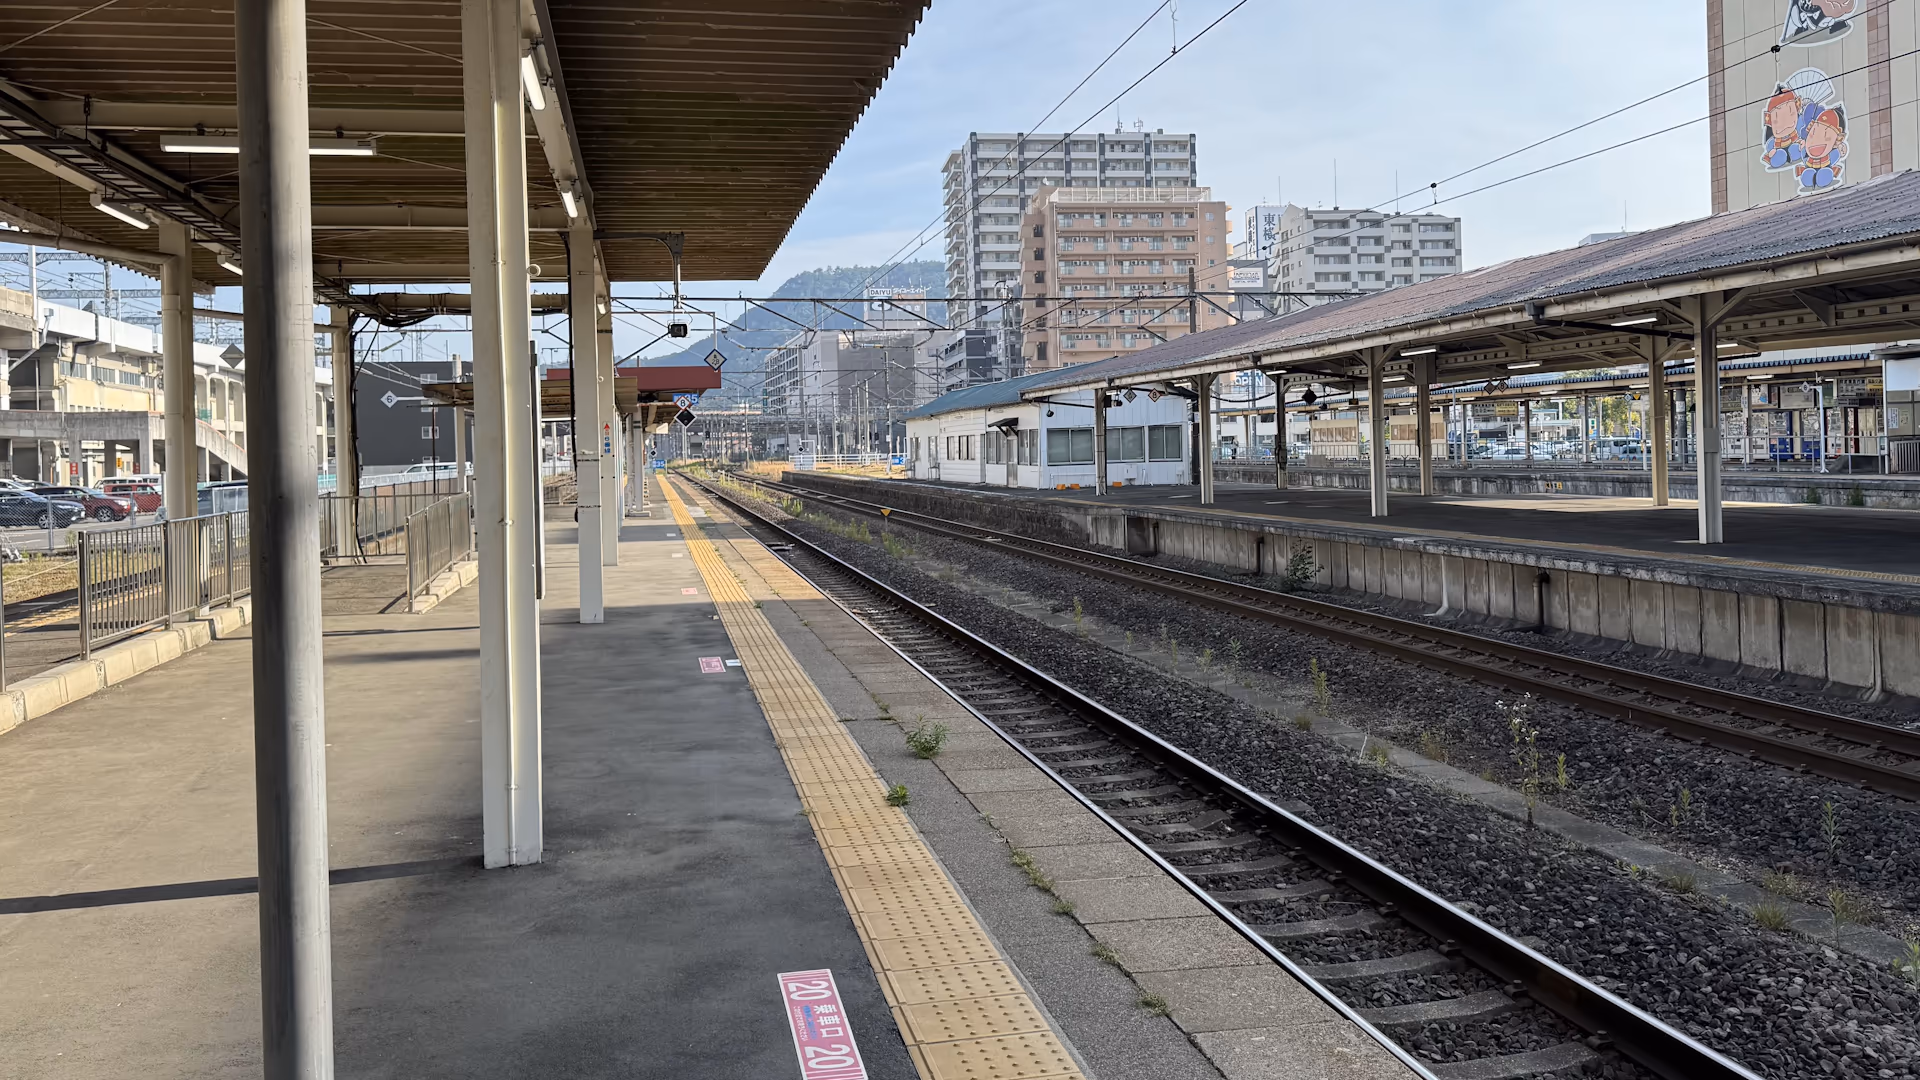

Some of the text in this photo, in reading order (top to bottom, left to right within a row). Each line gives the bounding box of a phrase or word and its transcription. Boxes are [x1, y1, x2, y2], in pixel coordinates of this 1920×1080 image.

[386, 395, 393, 404] 6
[787, 980, 854, 1069] 20 乗車口 20
